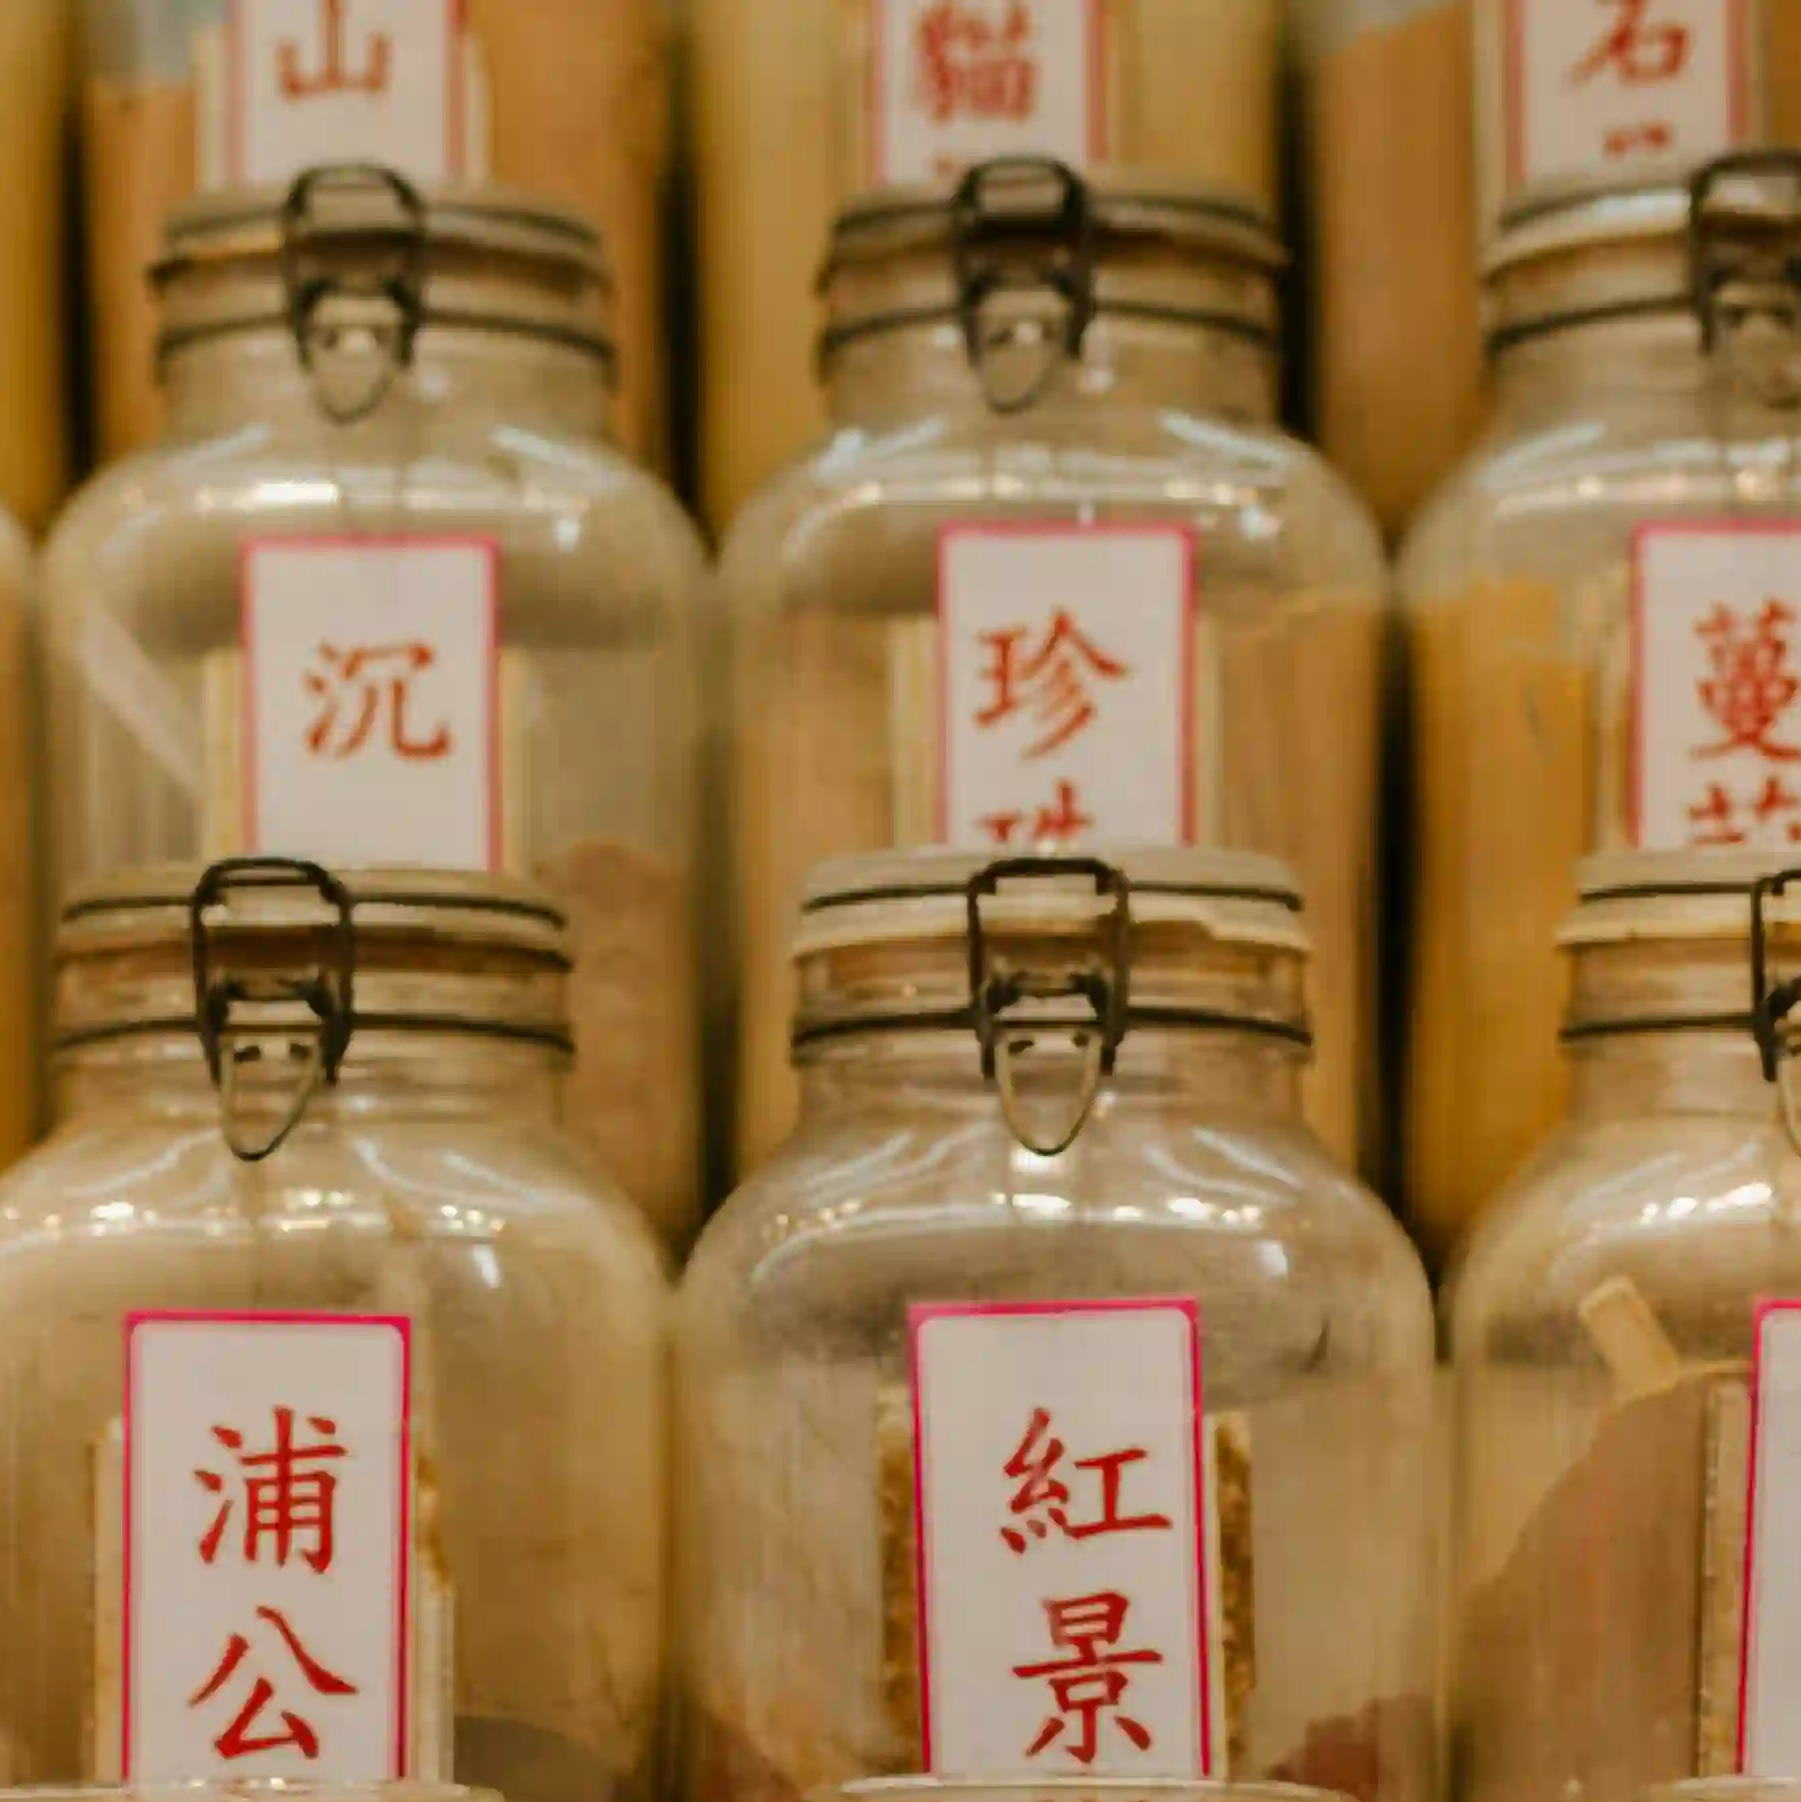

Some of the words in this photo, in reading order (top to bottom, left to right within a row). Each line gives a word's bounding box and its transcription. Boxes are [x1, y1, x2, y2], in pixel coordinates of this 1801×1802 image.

[305, 642, 454, 763] 沉
[191, 1407, 353, 1758] 浦公
[1000, 1411, 1169, 1764] 紅景
